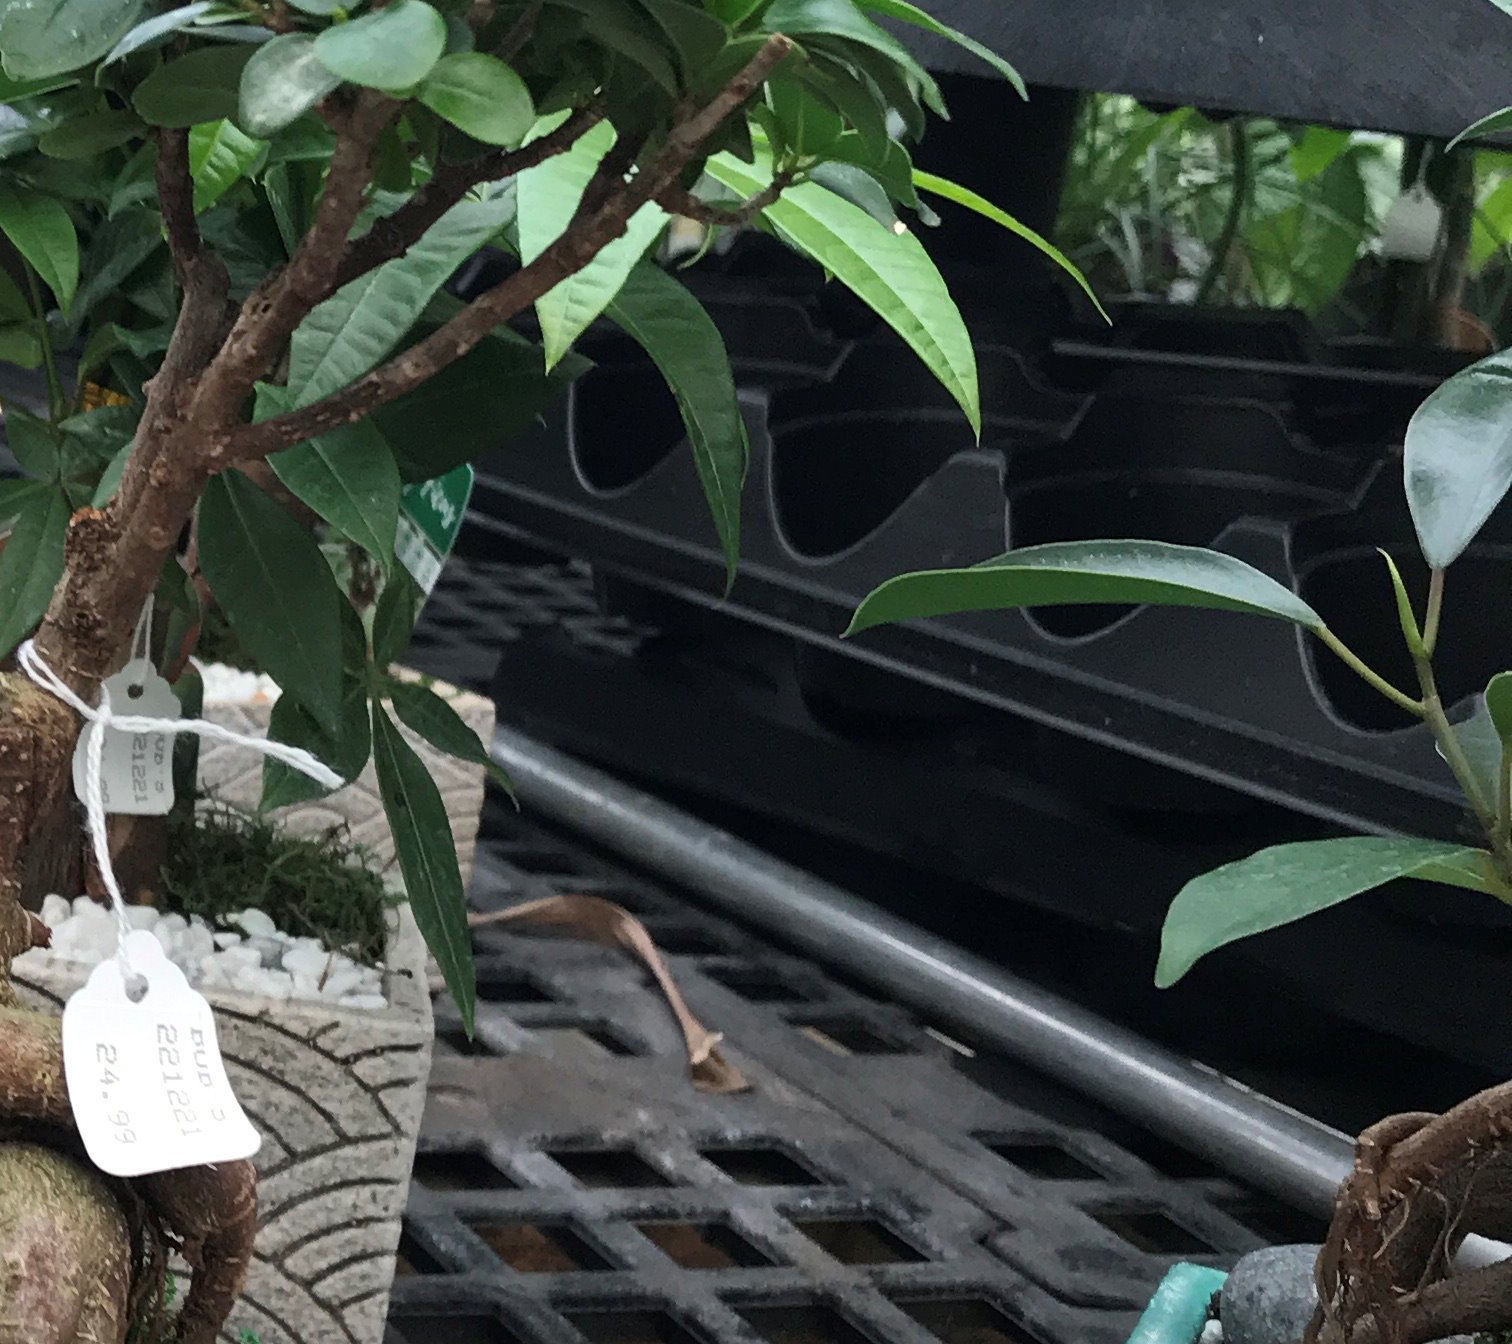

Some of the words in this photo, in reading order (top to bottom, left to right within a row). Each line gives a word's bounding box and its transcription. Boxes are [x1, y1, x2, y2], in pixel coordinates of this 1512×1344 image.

[132, 731, 148, 804] 21221
[96, 1042, 138, 1144] 24.99
[156, 1023, 202, 1136] 221221
